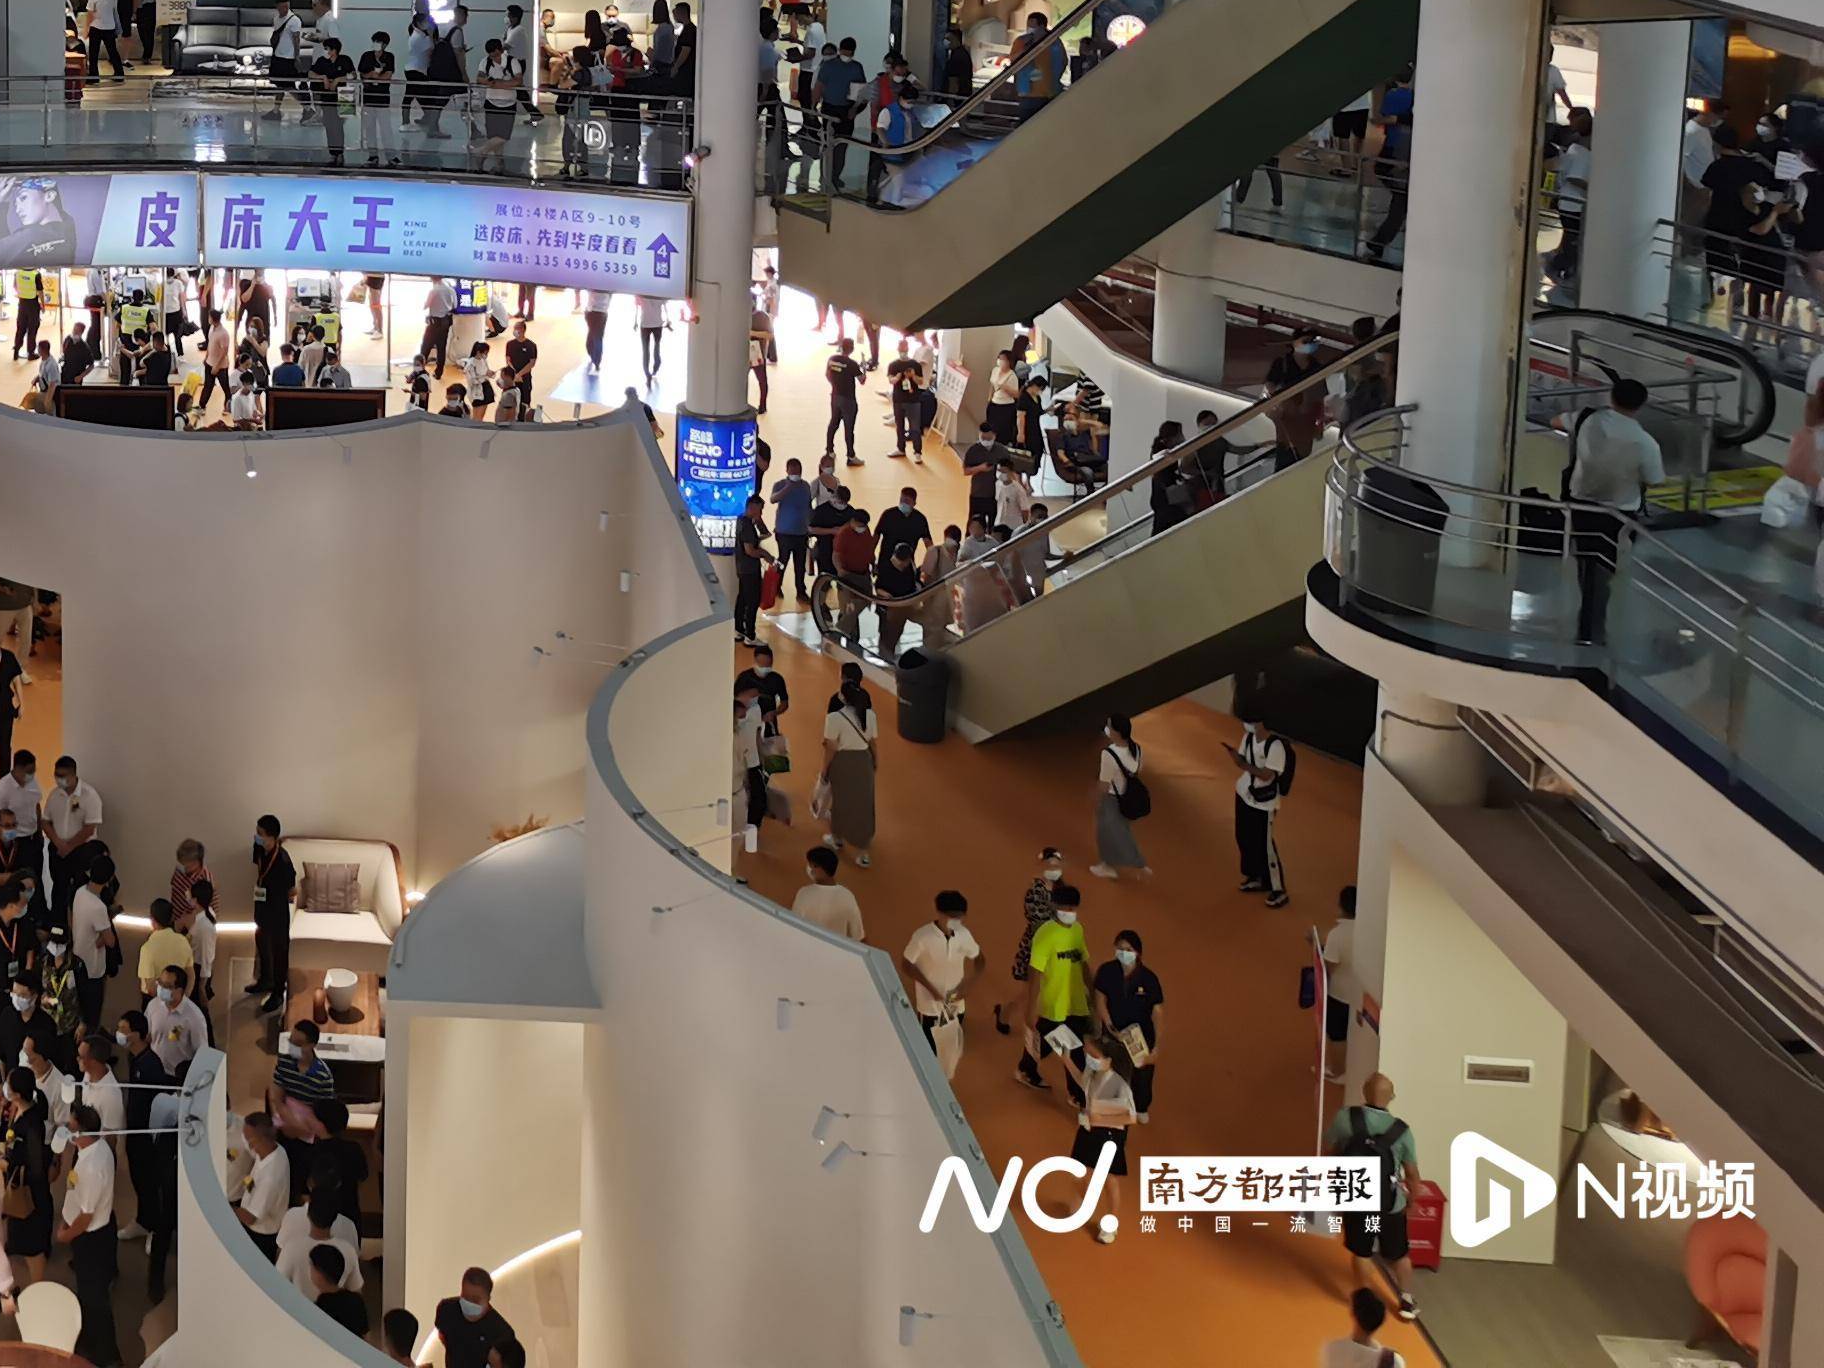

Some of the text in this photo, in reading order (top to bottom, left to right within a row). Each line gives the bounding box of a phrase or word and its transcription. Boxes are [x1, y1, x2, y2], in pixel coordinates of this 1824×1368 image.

[136, 191, 395, 255] 皮床大王
[534, 254, 559, 267] 135
[564, 257, 598, 271] 4996
[604, 261, 638, 276] 5359
